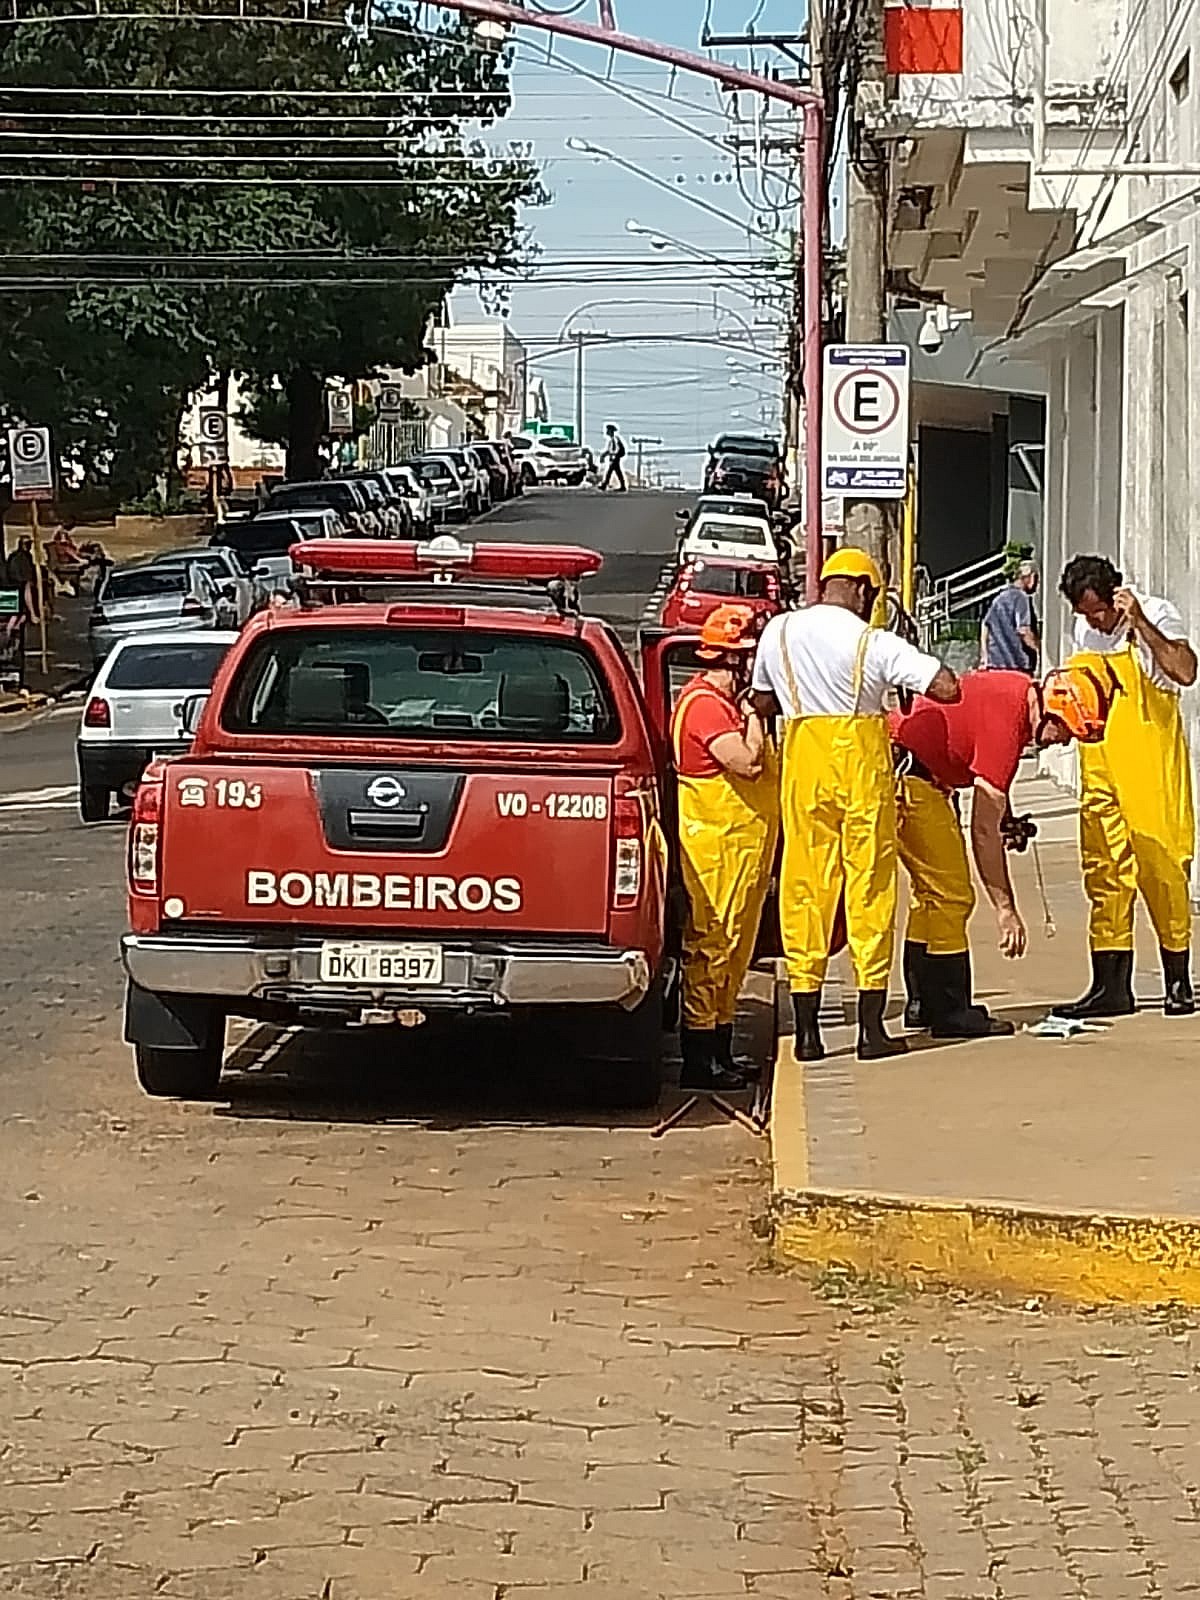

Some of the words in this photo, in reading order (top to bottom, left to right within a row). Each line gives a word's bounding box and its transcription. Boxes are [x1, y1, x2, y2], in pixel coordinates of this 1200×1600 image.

[854, 381, 879, 422] E
[208, 418, 220, 435] E
[22, 436, 36, 456] E
[214, 779, 262, 809] 193
[545, 793, 607, 820] 12208
[247, 870, 522, 912] BOMBEIROS
[379, 957, 436, 979] 8397
